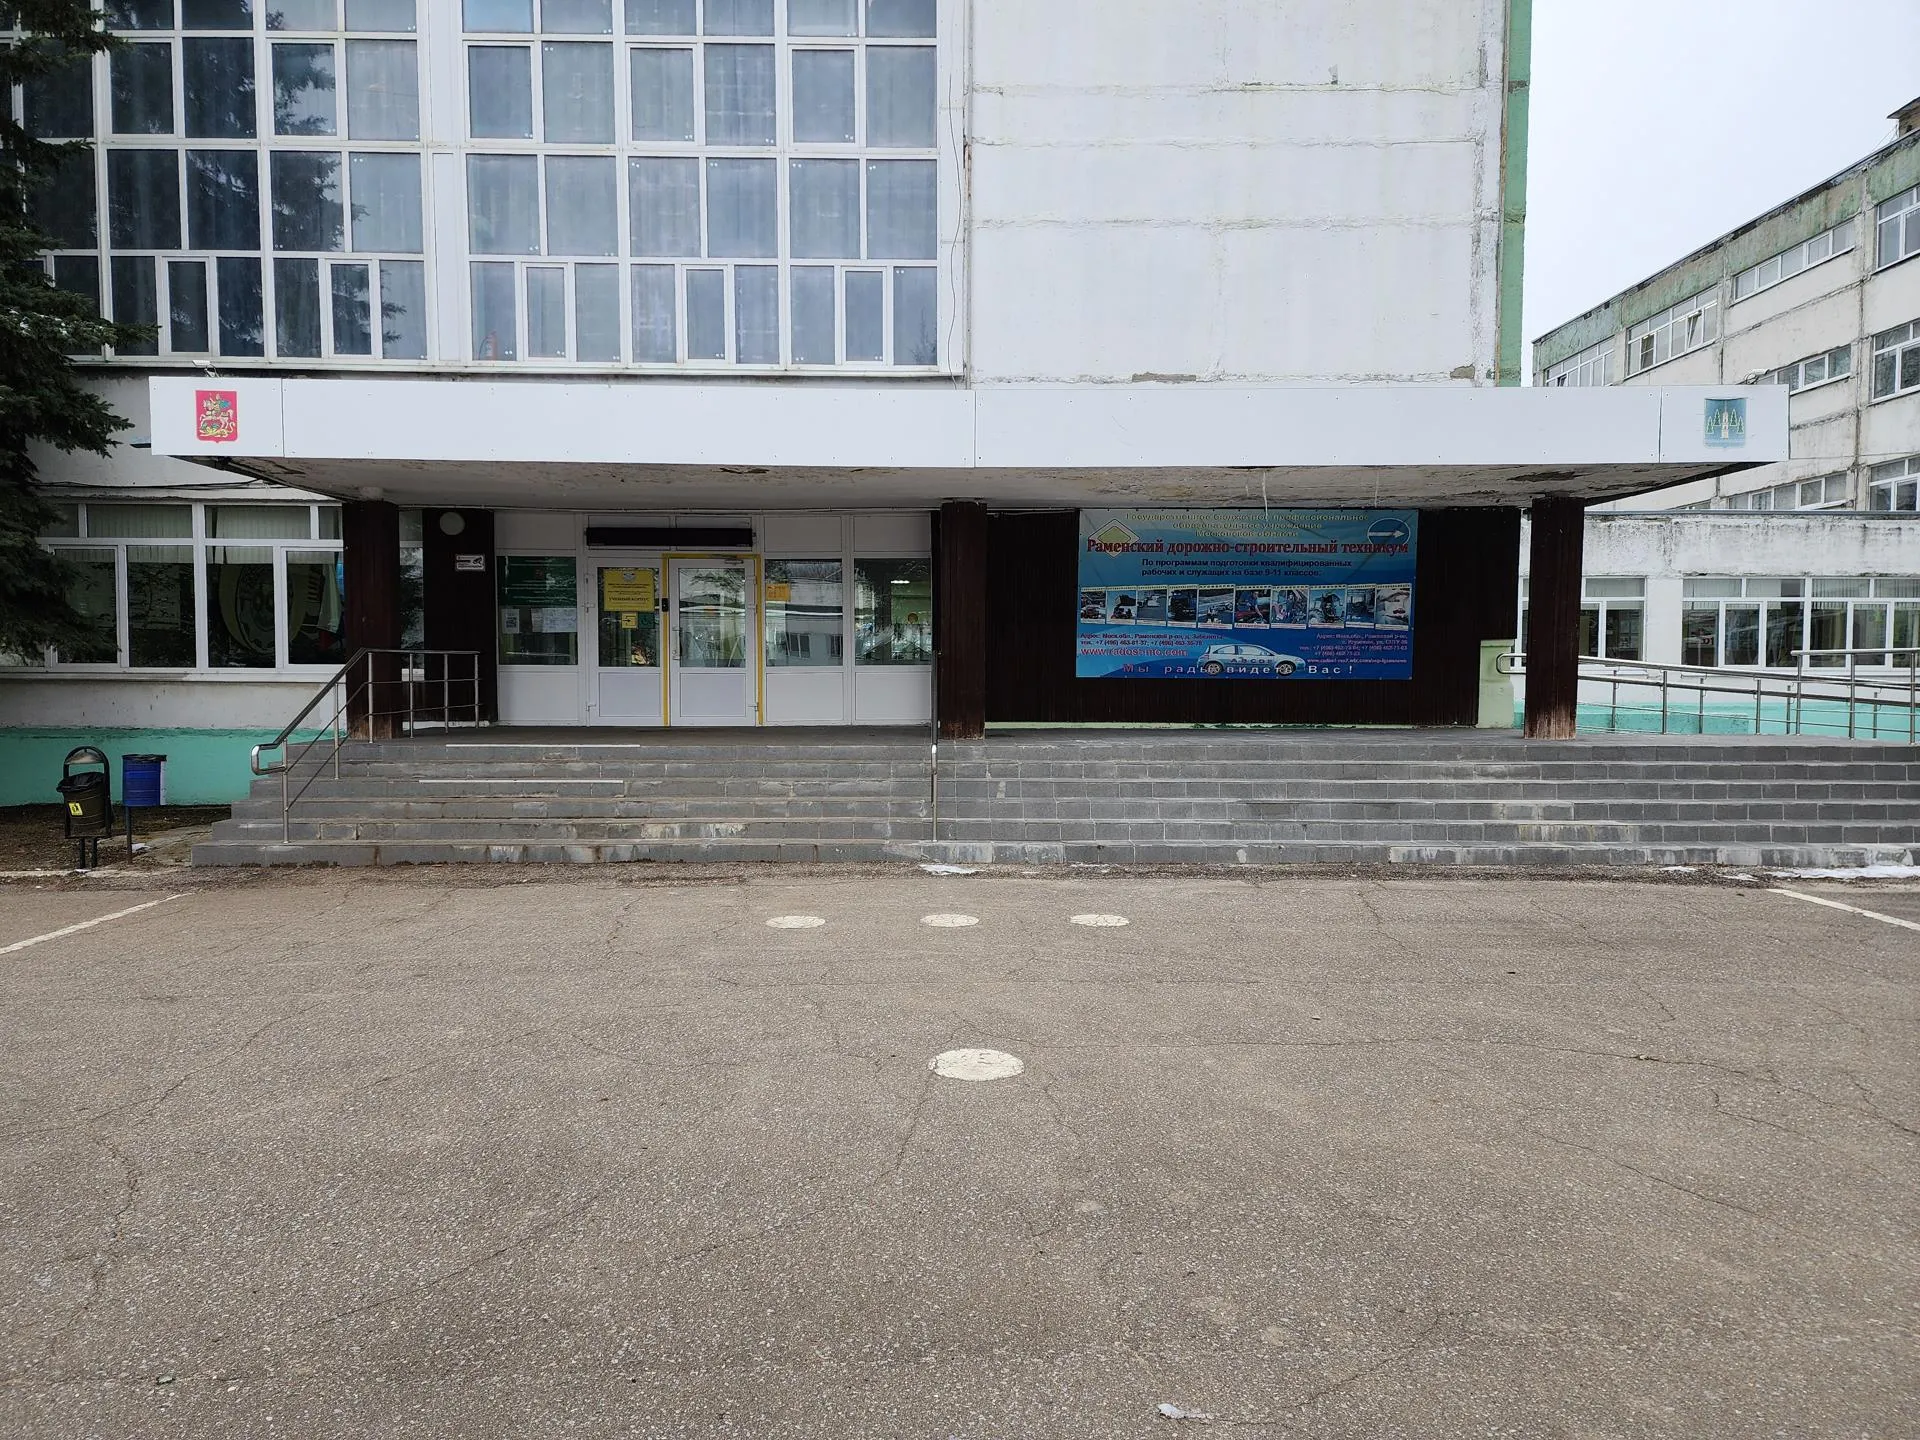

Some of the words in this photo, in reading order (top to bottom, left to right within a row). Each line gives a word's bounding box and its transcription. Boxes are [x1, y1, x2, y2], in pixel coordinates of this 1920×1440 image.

[1086, 539, 1164, 553] Раменский
[1167, 540, 1337, 556] дорожно-строительный
[1341, 542, 1409, 557] техникум
[1142, 559, 1153, 567] По
[1157, 560, 1208, 568] программам
[1210, 559, 1259, 569] подготовки
[1261, 558, 1352, 570] квалифицированных
[1141, 567, 1177, 576] рабочих
[1180, 568, 1186, 576] и
[1187, 568, 1229, 577] служащих
[1244, 567, 1264, 577] базе
[1264, 568, 1283, 577] 9-11
[1123, 664, 1150, 673] Мы
